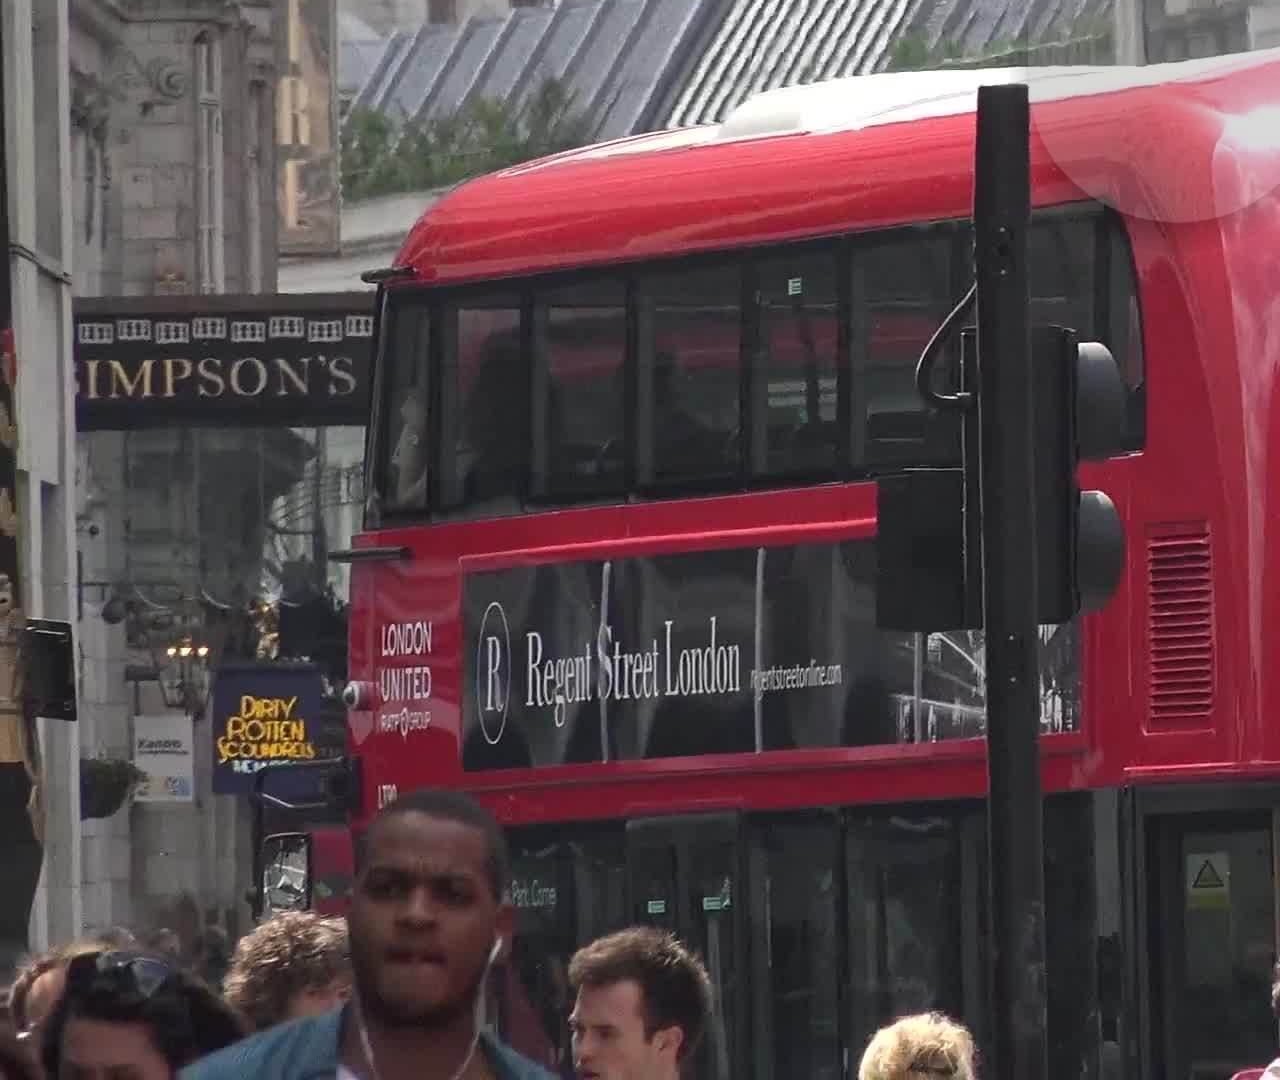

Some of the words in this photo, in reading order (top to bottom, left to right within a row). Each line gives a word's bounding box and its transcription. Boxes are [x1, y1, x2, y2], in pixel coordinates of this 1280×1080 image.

[75, 357, 357, 399] IMPSON'S
[381, 621, 432, 657] LONDON
[380, 666, 432, 702] UNITED
[485, 636, 504, 713] R
[525, 631, 592, 727] Regent
[597, 622, 660, 700] Street
[664, 616, 741, 697] London
[241, 695, 298, 719] DIRTY
[226, 716, 305, 741] ROTTEN
[216, 736, 317, 765] SCOUNDRELS
